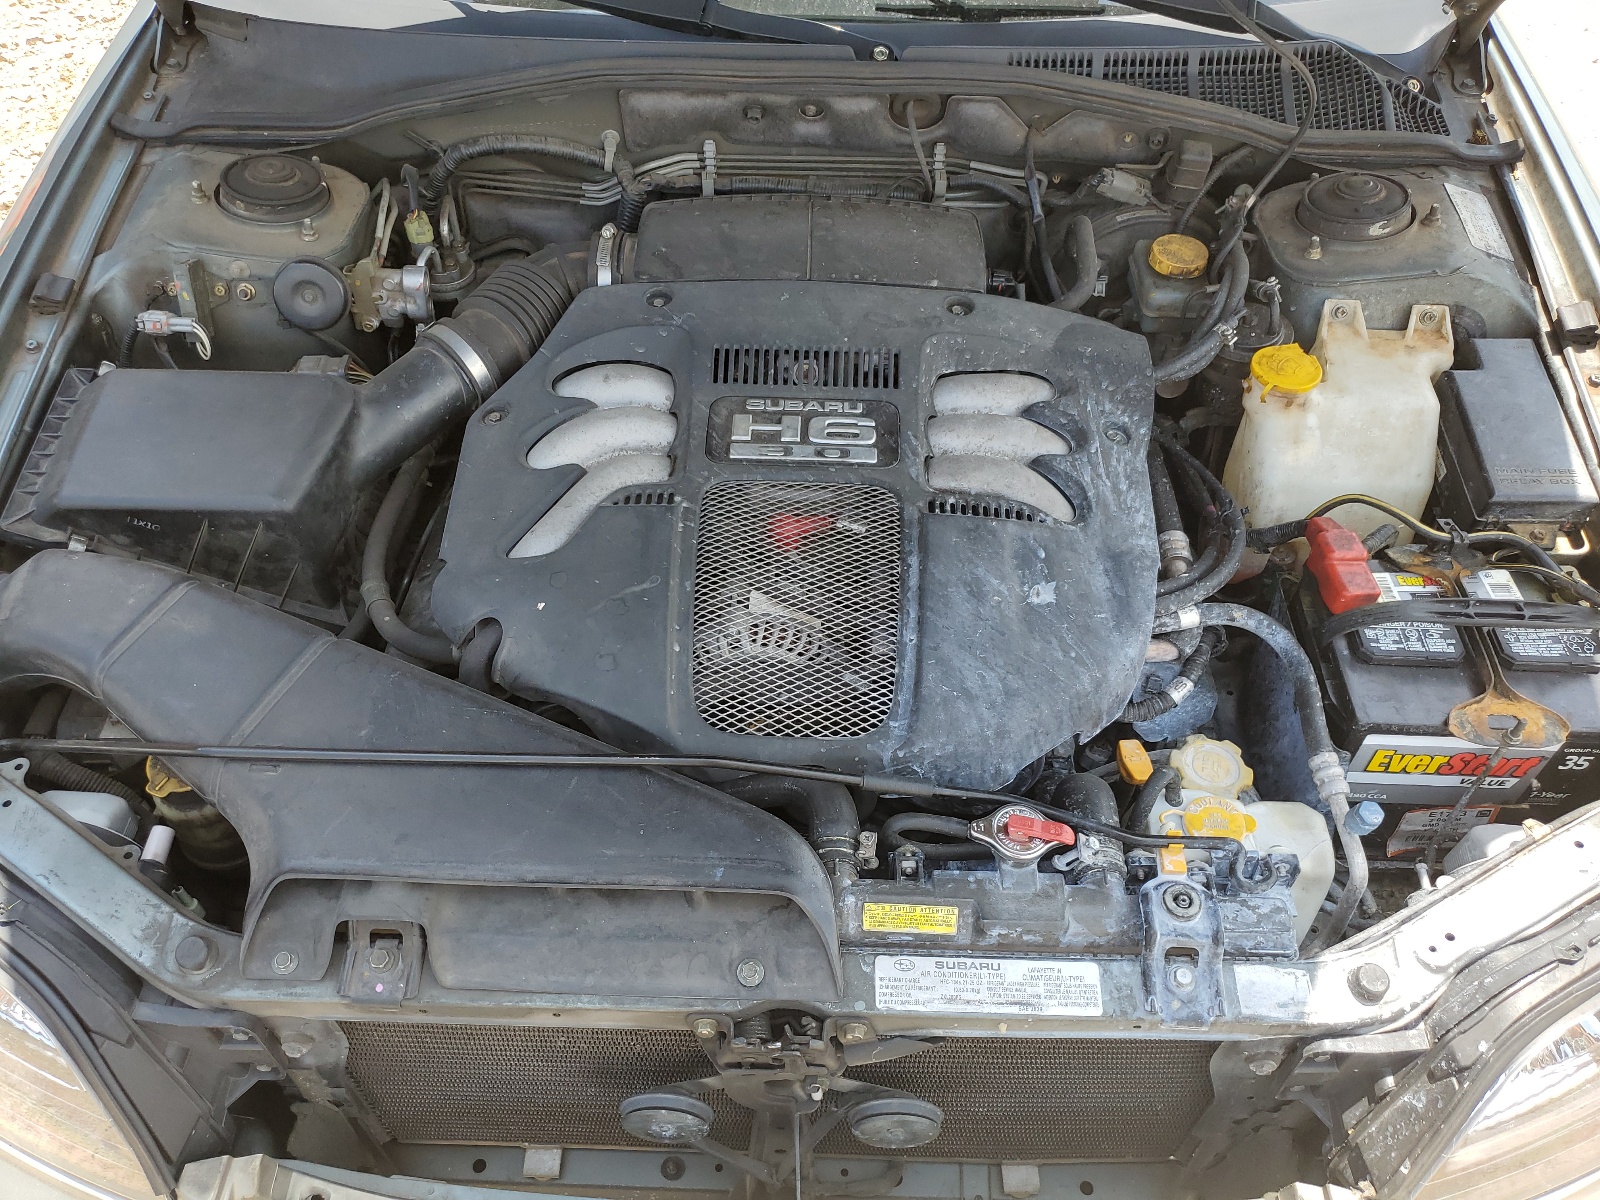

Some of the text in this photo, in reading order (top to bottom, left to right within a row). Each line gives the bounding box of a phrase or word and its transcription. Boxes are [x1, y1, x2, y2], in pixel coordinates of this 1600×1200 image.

[745, 399, 863, 413] SUBARU
[731, 414, 877, 445] H6
[1364, 748, 1545, 777] EverStart
[1557, 755, 1595, 770] 35
[1188, 796, 1239, 814] COOLANT
[889, 905, 917, 913] CAUTION
[934, 960, 1001, 971] SUBARU
[920, 970, 932, 979] AIR
